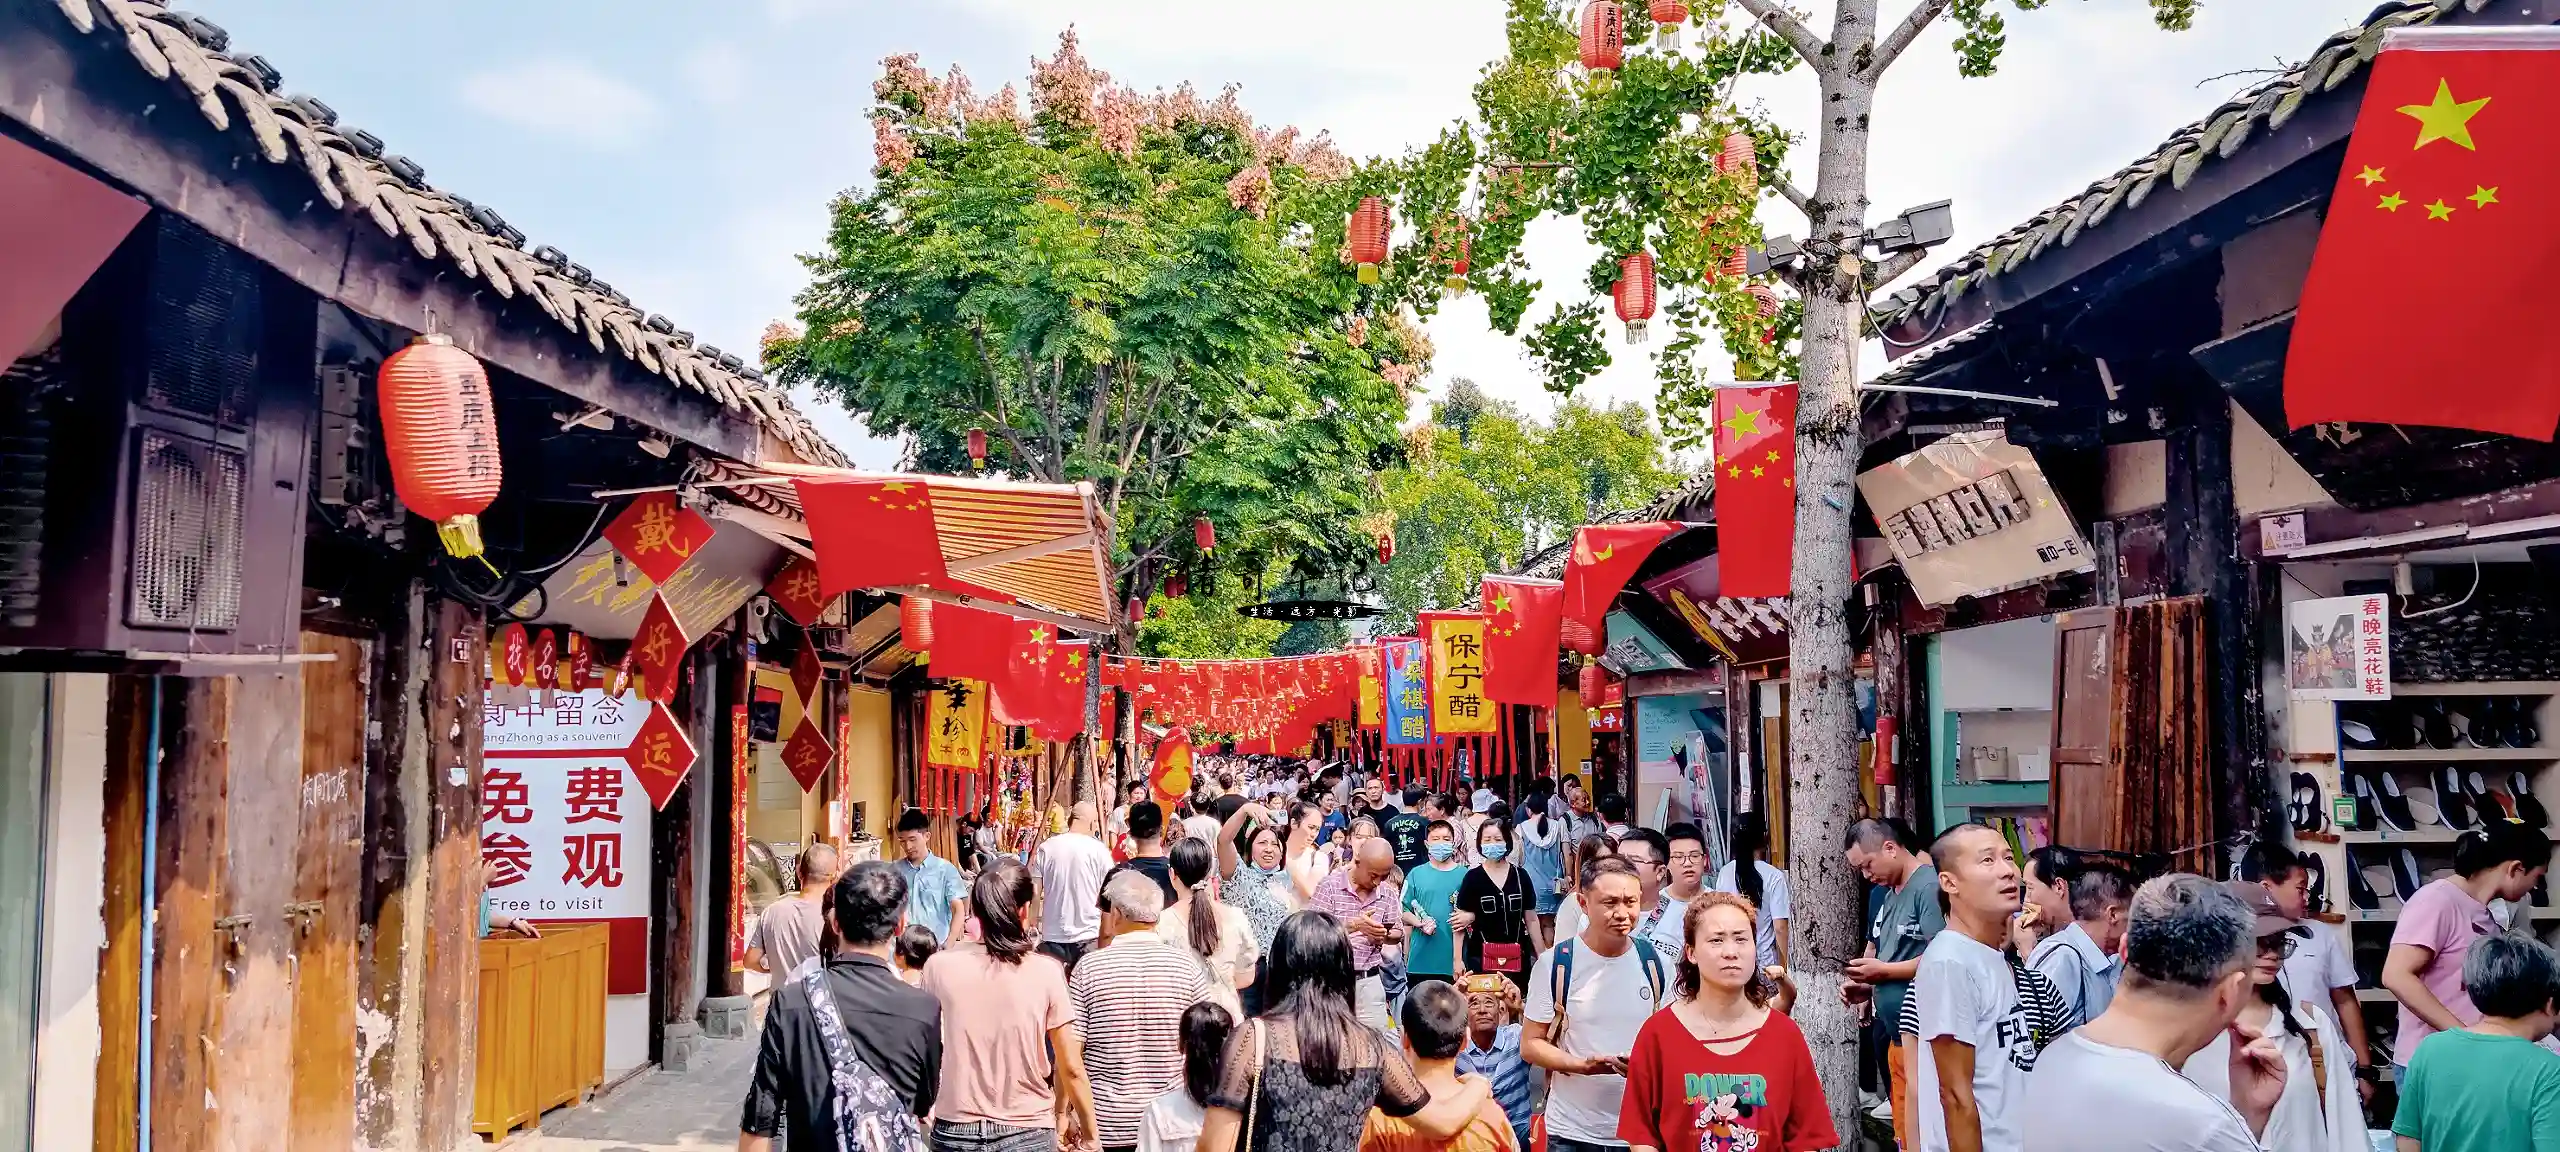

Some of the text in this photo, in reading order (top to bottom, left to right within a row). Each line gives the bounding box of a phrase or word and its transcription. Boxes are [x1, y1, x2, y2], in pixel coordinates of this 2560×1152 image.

[2362, 597, 2385, 695] 春晚亮花鞋
[1444, 634, 1482, 718] 保宁醋
[484, 732, 543, 745] angZhong
[547, 734, 559, 742] as
[571, 732, 622, 742] souvenir
[483, 766, 624, 825] 免费
[483, 831, 624, 889] 参观
[489, 896, 604, 911] Free to visit
[1684, 1072, 1768, 1107] POWER
